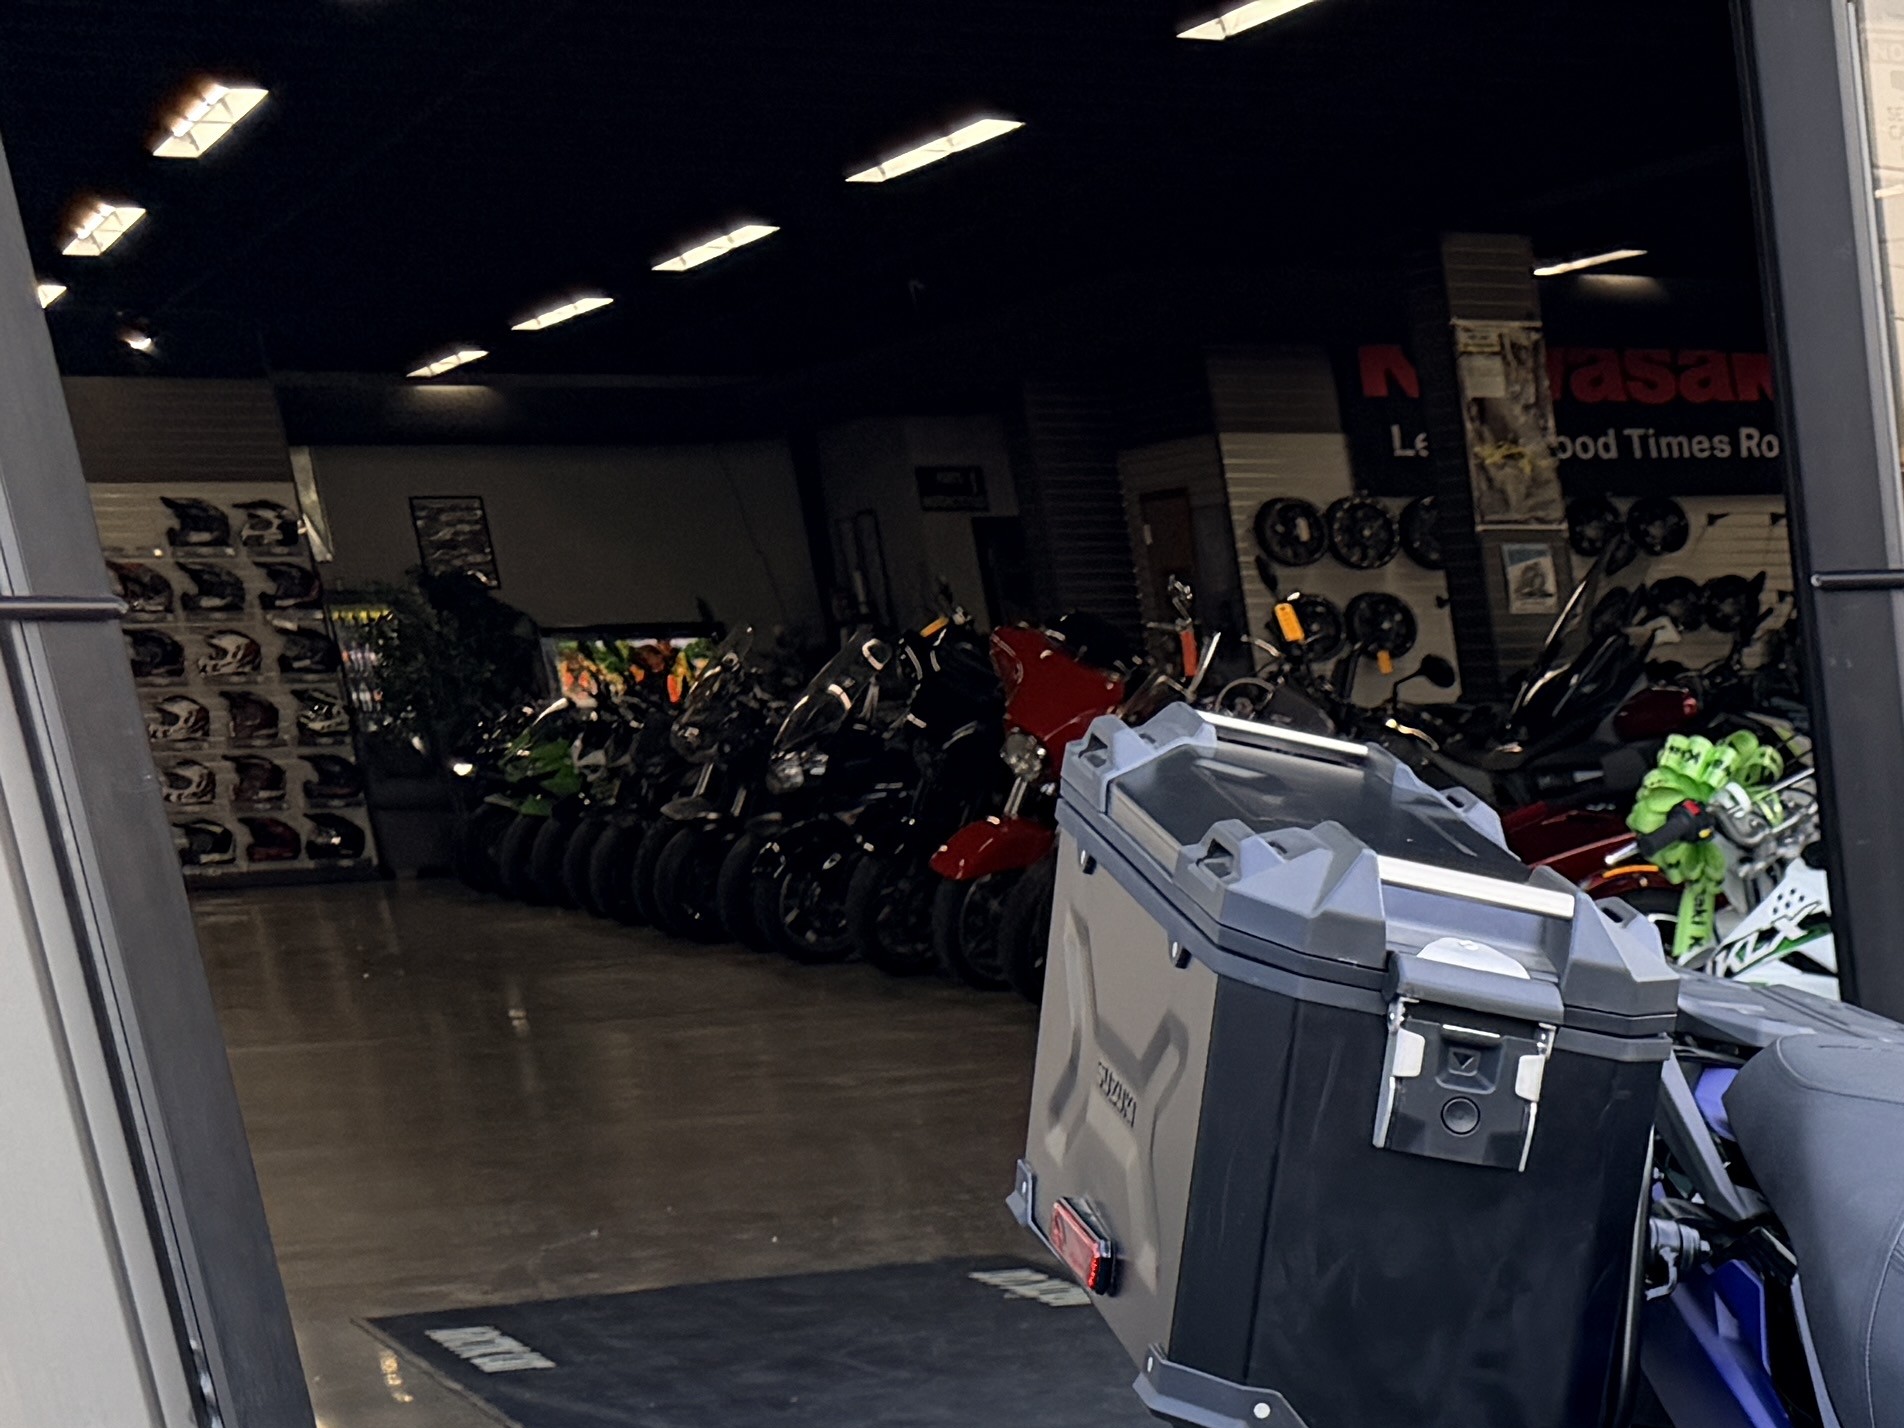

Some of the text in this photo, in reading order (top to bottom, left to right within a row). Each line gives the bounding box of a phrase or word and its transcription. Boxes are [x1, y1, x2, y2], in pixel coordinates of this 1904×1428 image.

[1556, 426, 1619, 460] ood
[1622, 428, 1731, 461] Times
[1098, 1061, 1138, 1129] SUZUKI
